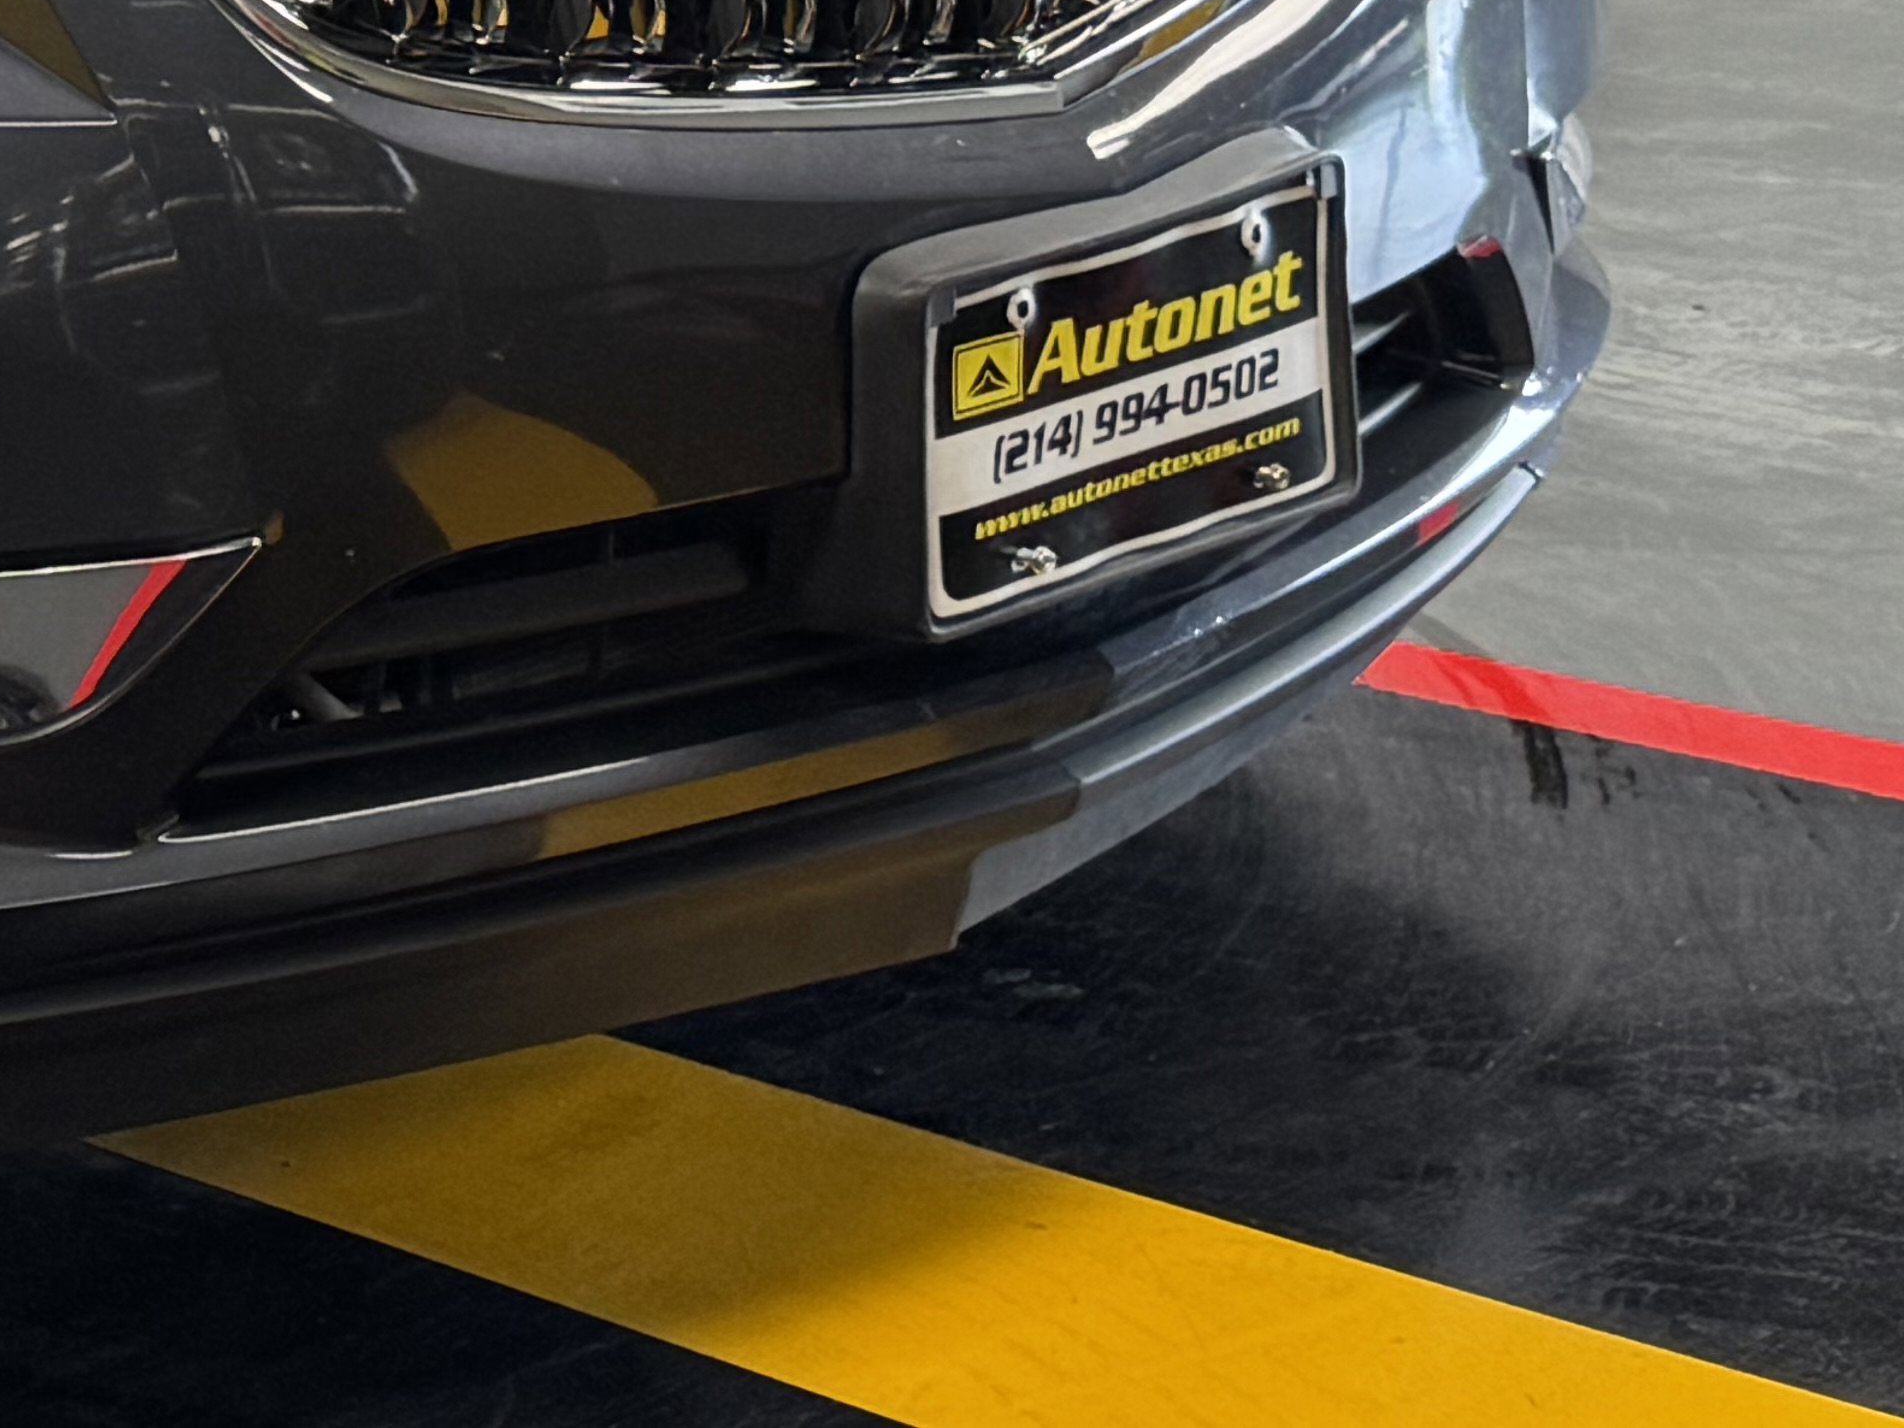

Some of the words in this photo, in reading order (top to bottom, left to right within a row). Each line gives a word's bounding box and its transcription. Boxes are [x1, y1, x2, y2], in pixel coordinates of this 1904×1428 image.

[1026, 250, 1304, 395] Autonet
[974, 416, 1300, 540] www.autonettexas.com
[993, 409, 1083, 484] (214)
[1094, 347, 1280, 446] 994-0502
